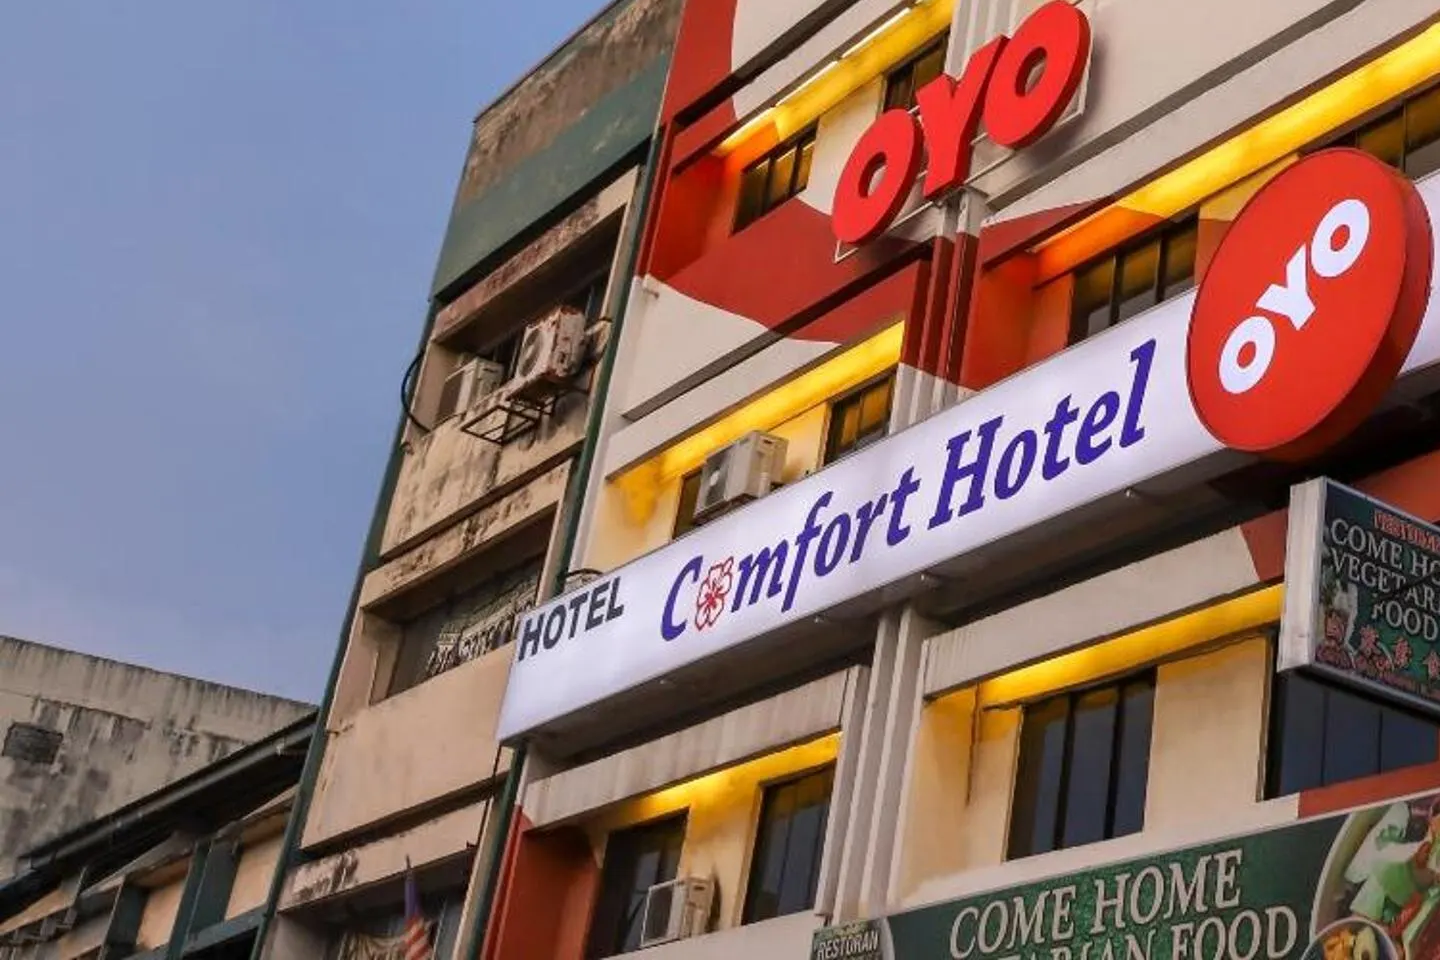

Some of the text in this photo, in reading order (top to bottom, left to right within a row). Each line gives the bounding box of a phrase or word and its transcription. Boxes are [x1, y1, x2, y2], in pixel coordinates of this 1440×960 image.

[832, 0, 1091, 245] OYO
[1218, 198, 1370, 394] OYO
[928, 338, 1157, 531] Hotel
[1330, 518, 1403, 568] COME
[518, 576, 624, 662] HOTEL
[950, 848, 1241, 959] COME HOME
[1171, 905, 1298, 960] FOOD
